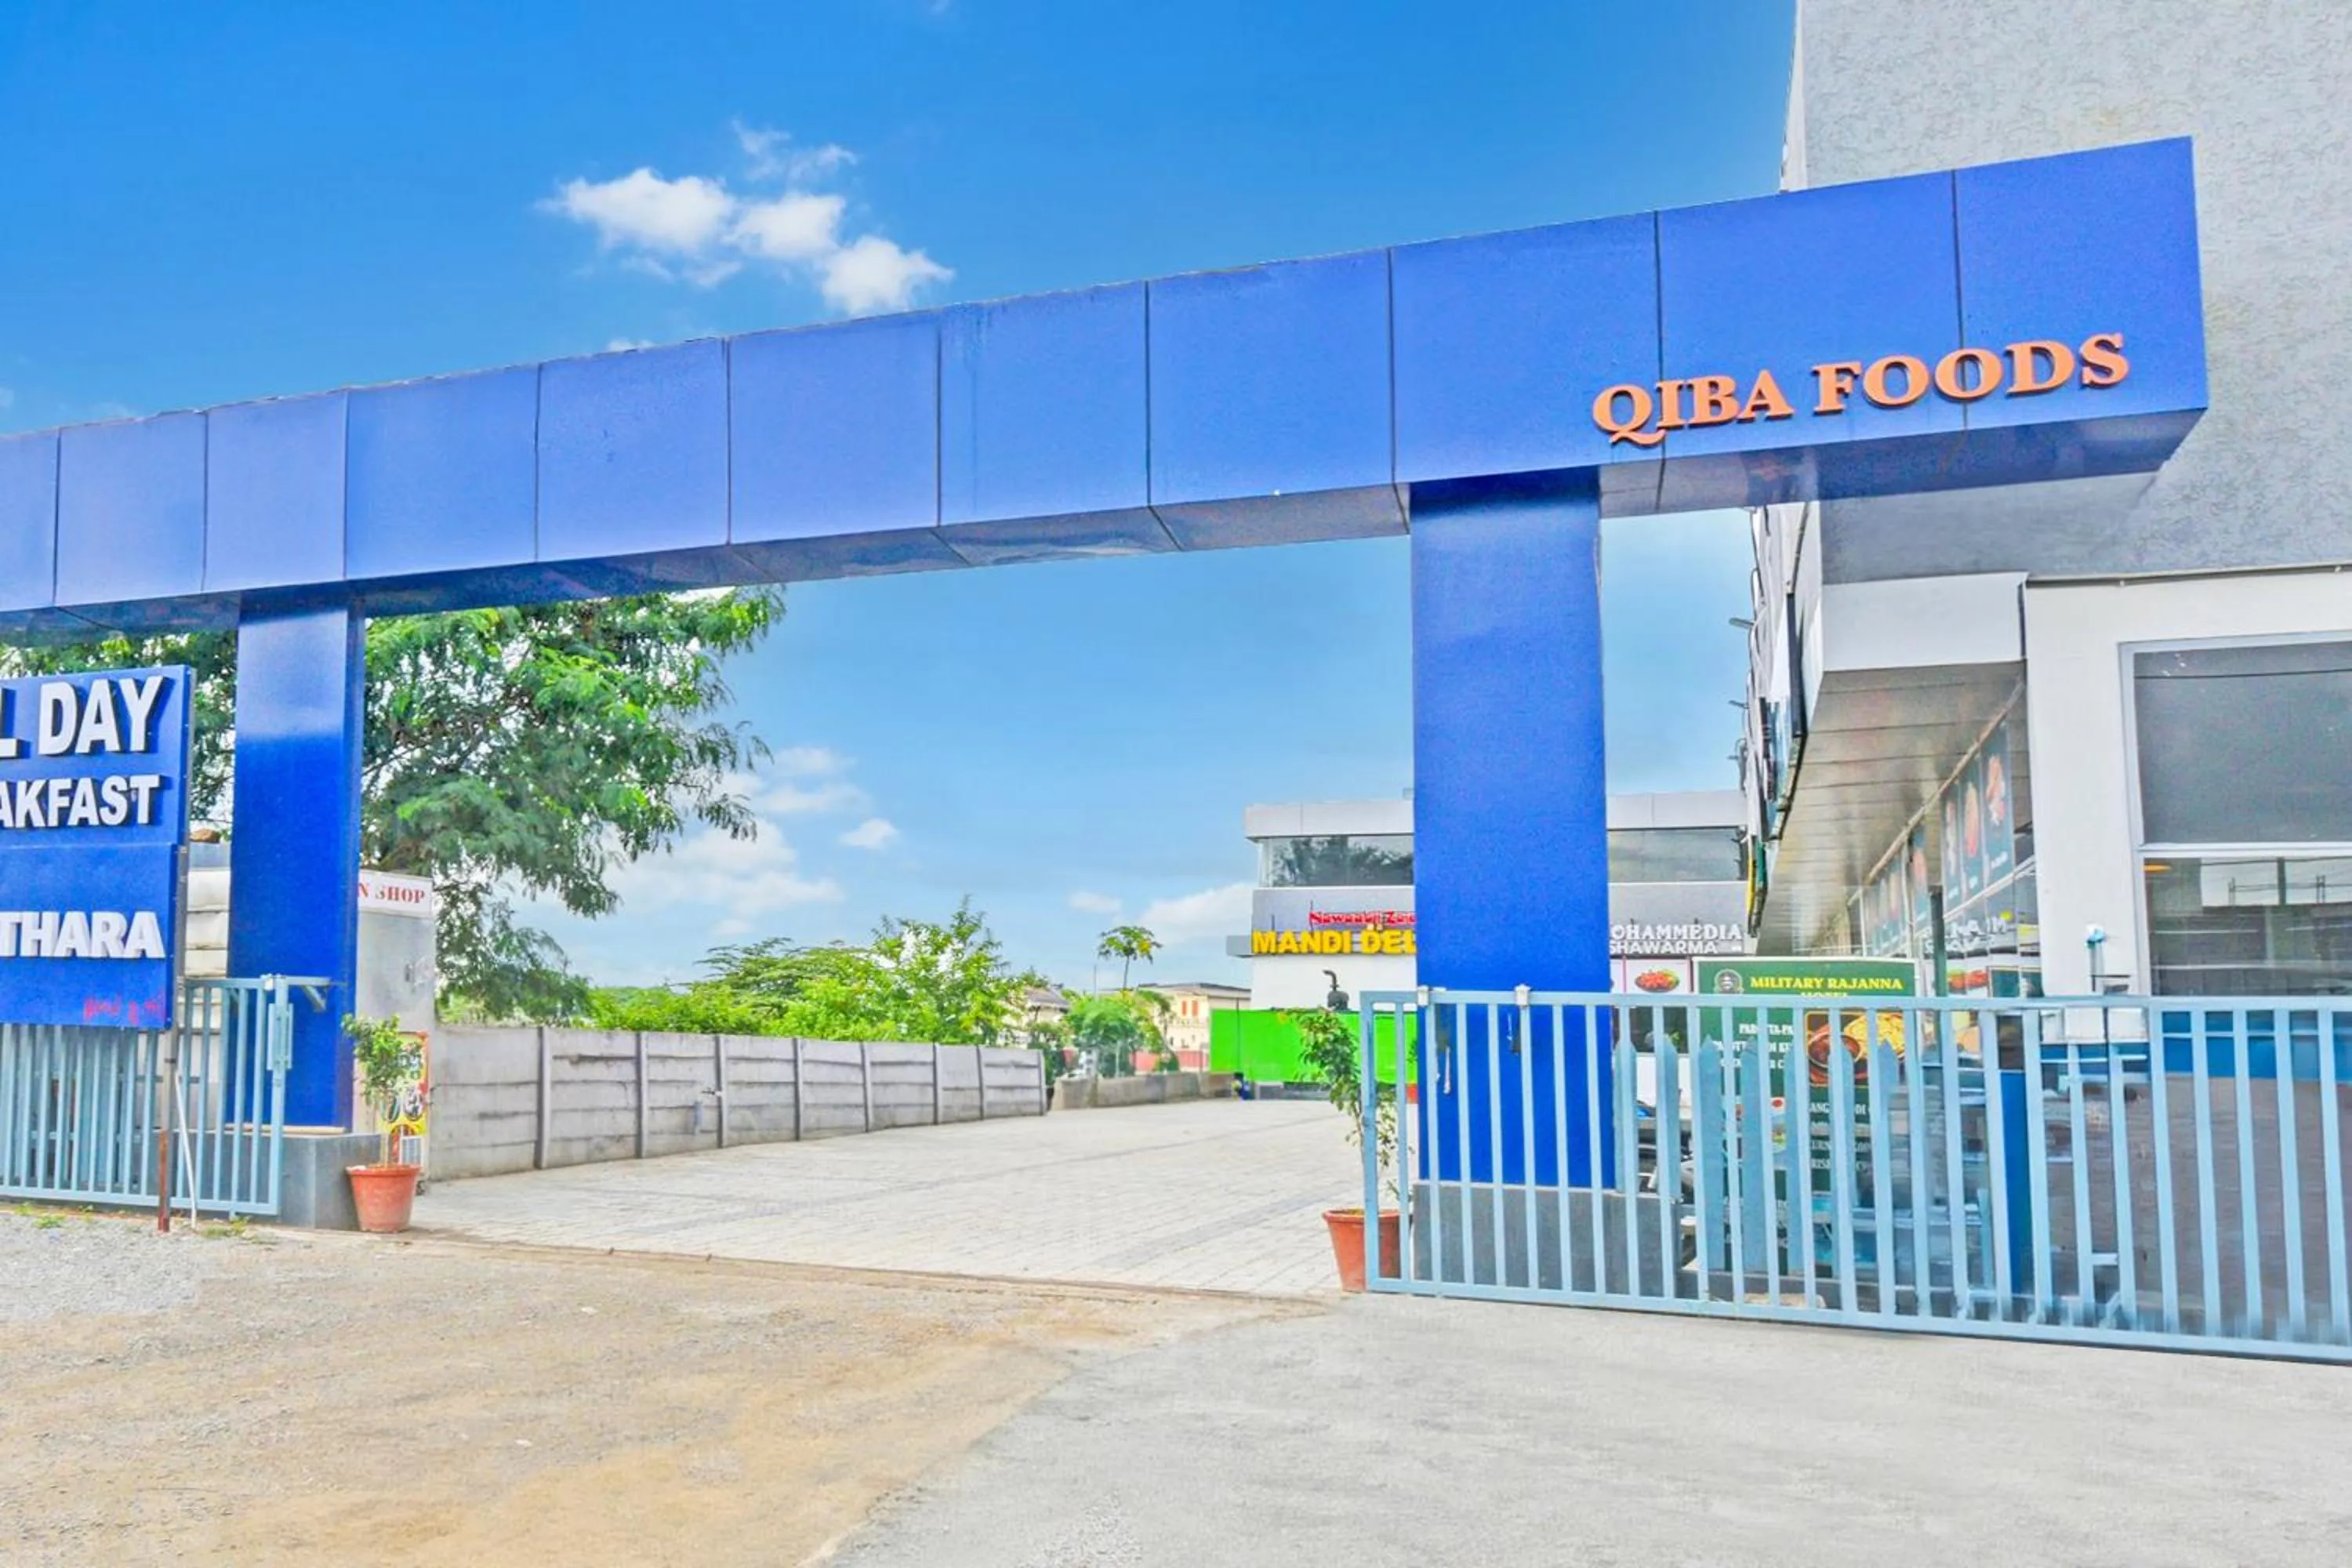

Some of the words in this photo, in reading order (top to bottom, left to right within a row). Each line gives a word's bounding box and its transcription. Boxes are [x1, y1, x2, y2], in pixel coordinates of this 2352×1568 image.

[1592, 369, 1795, 445] QIBA
[1812, 332, 2130, 413] FOODS
[38, 675, 164, 756] DAY
[375, 885, 425, 904] SHOP
[1252, 929, 1352, 954] MANDI
[1610, 941, 1719, 955] SHAWARMA
[1749, 976, 1824, 990] MILITARY
[1827, 977, 1904, 991] RAJANNA
